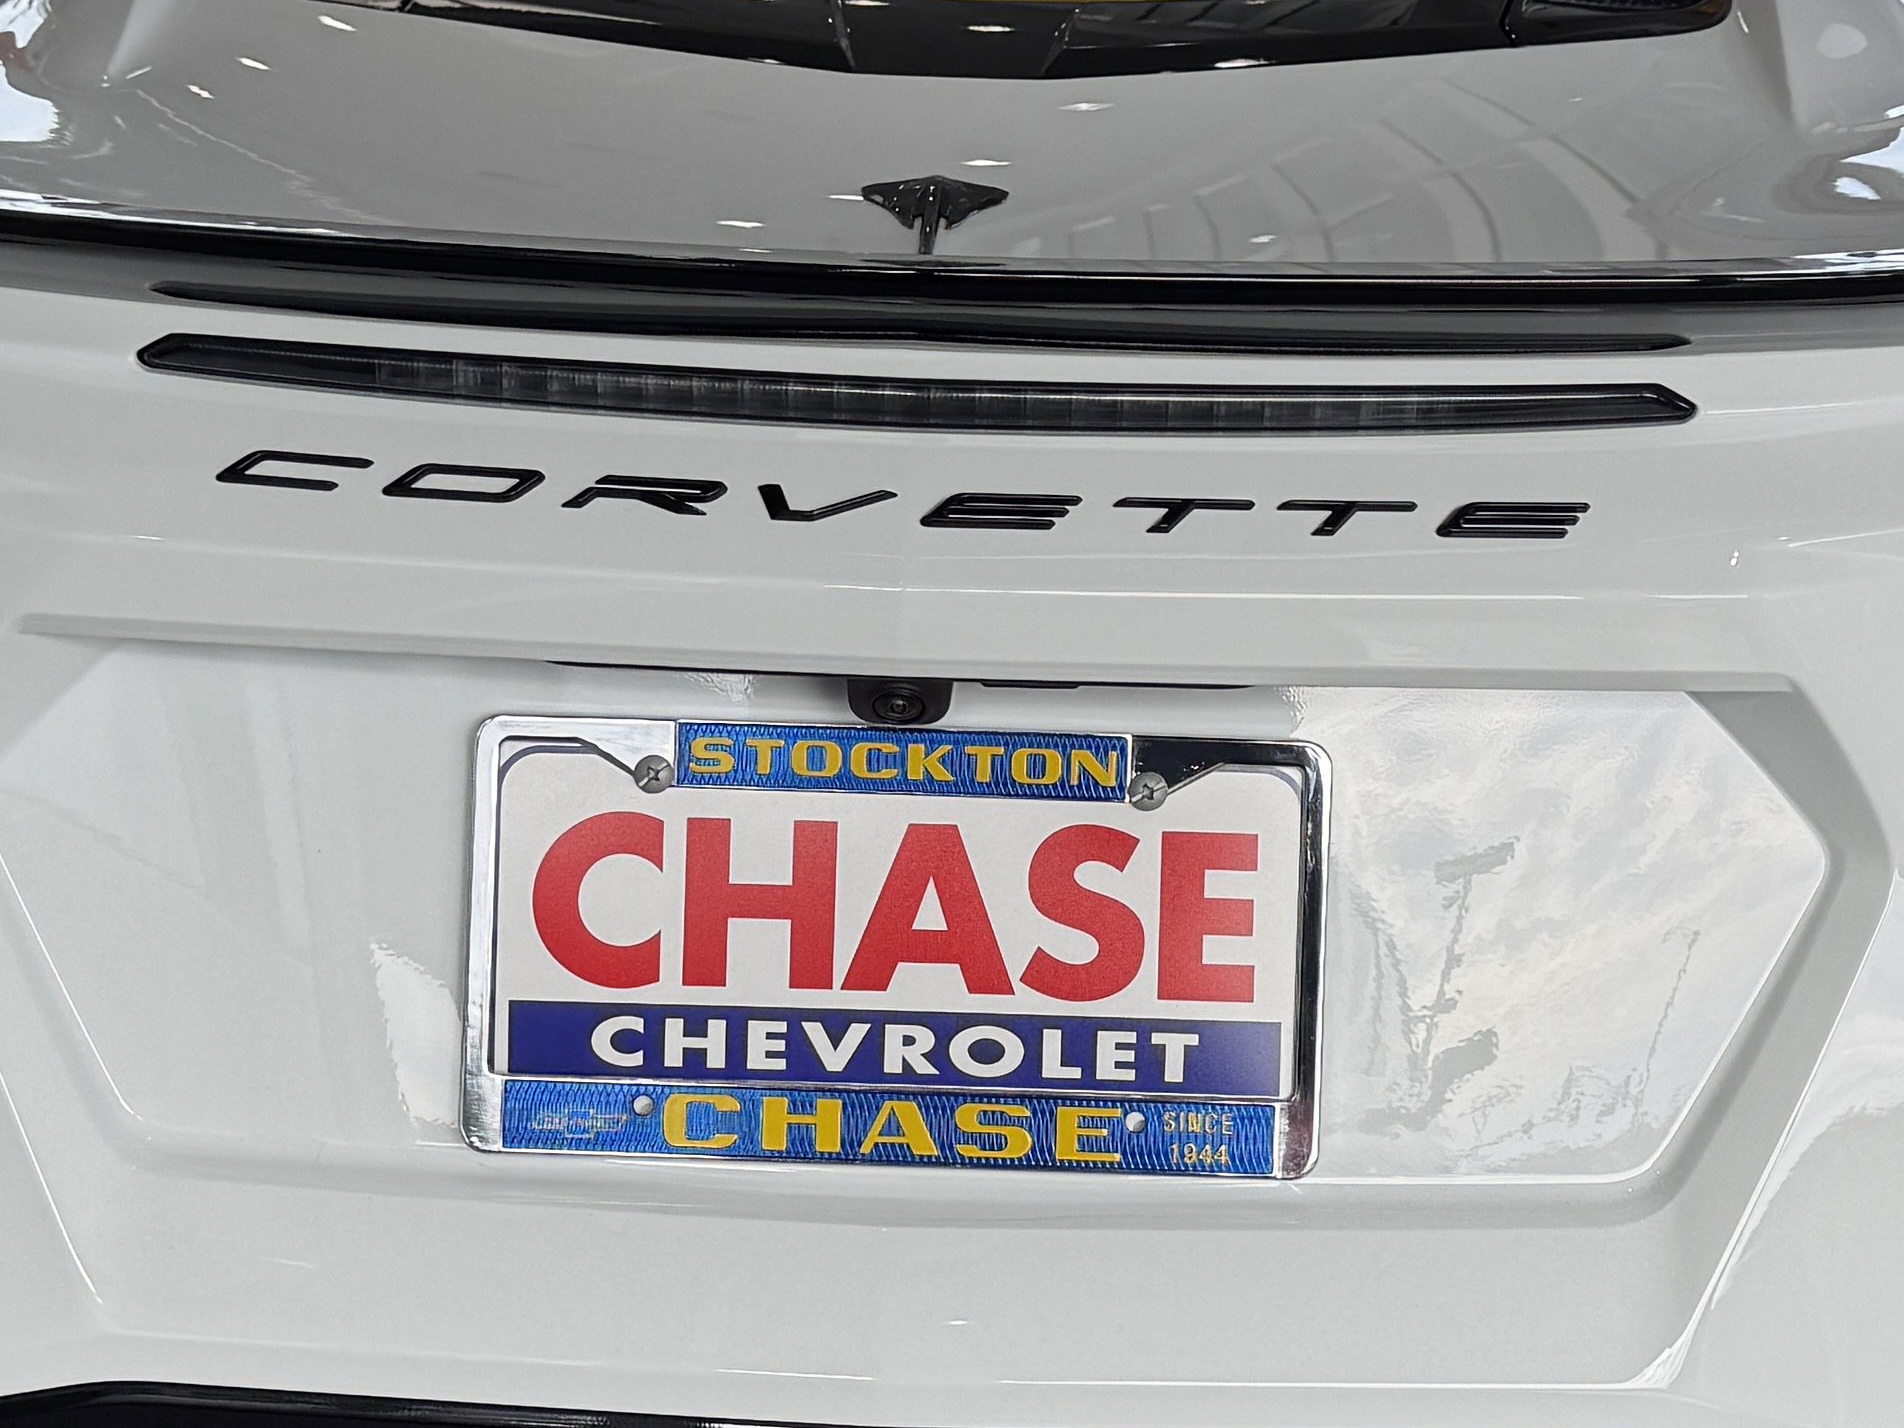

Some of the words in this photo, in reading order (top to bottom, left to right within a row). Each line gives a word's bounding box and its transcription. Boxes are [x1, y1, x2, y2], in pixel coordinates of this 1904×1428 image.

[215, 449, 1591, 540] CORVETTE
[688, 735, 1118, 788] STOCKTON
[532, 811, 1258, 1003] CHASE
[590, 1016, 1200, 1084] CHEVROLET
[663, 1093, 1122, 1163] CHASE
[1163, 1111, 1234, 1135] SINCE
